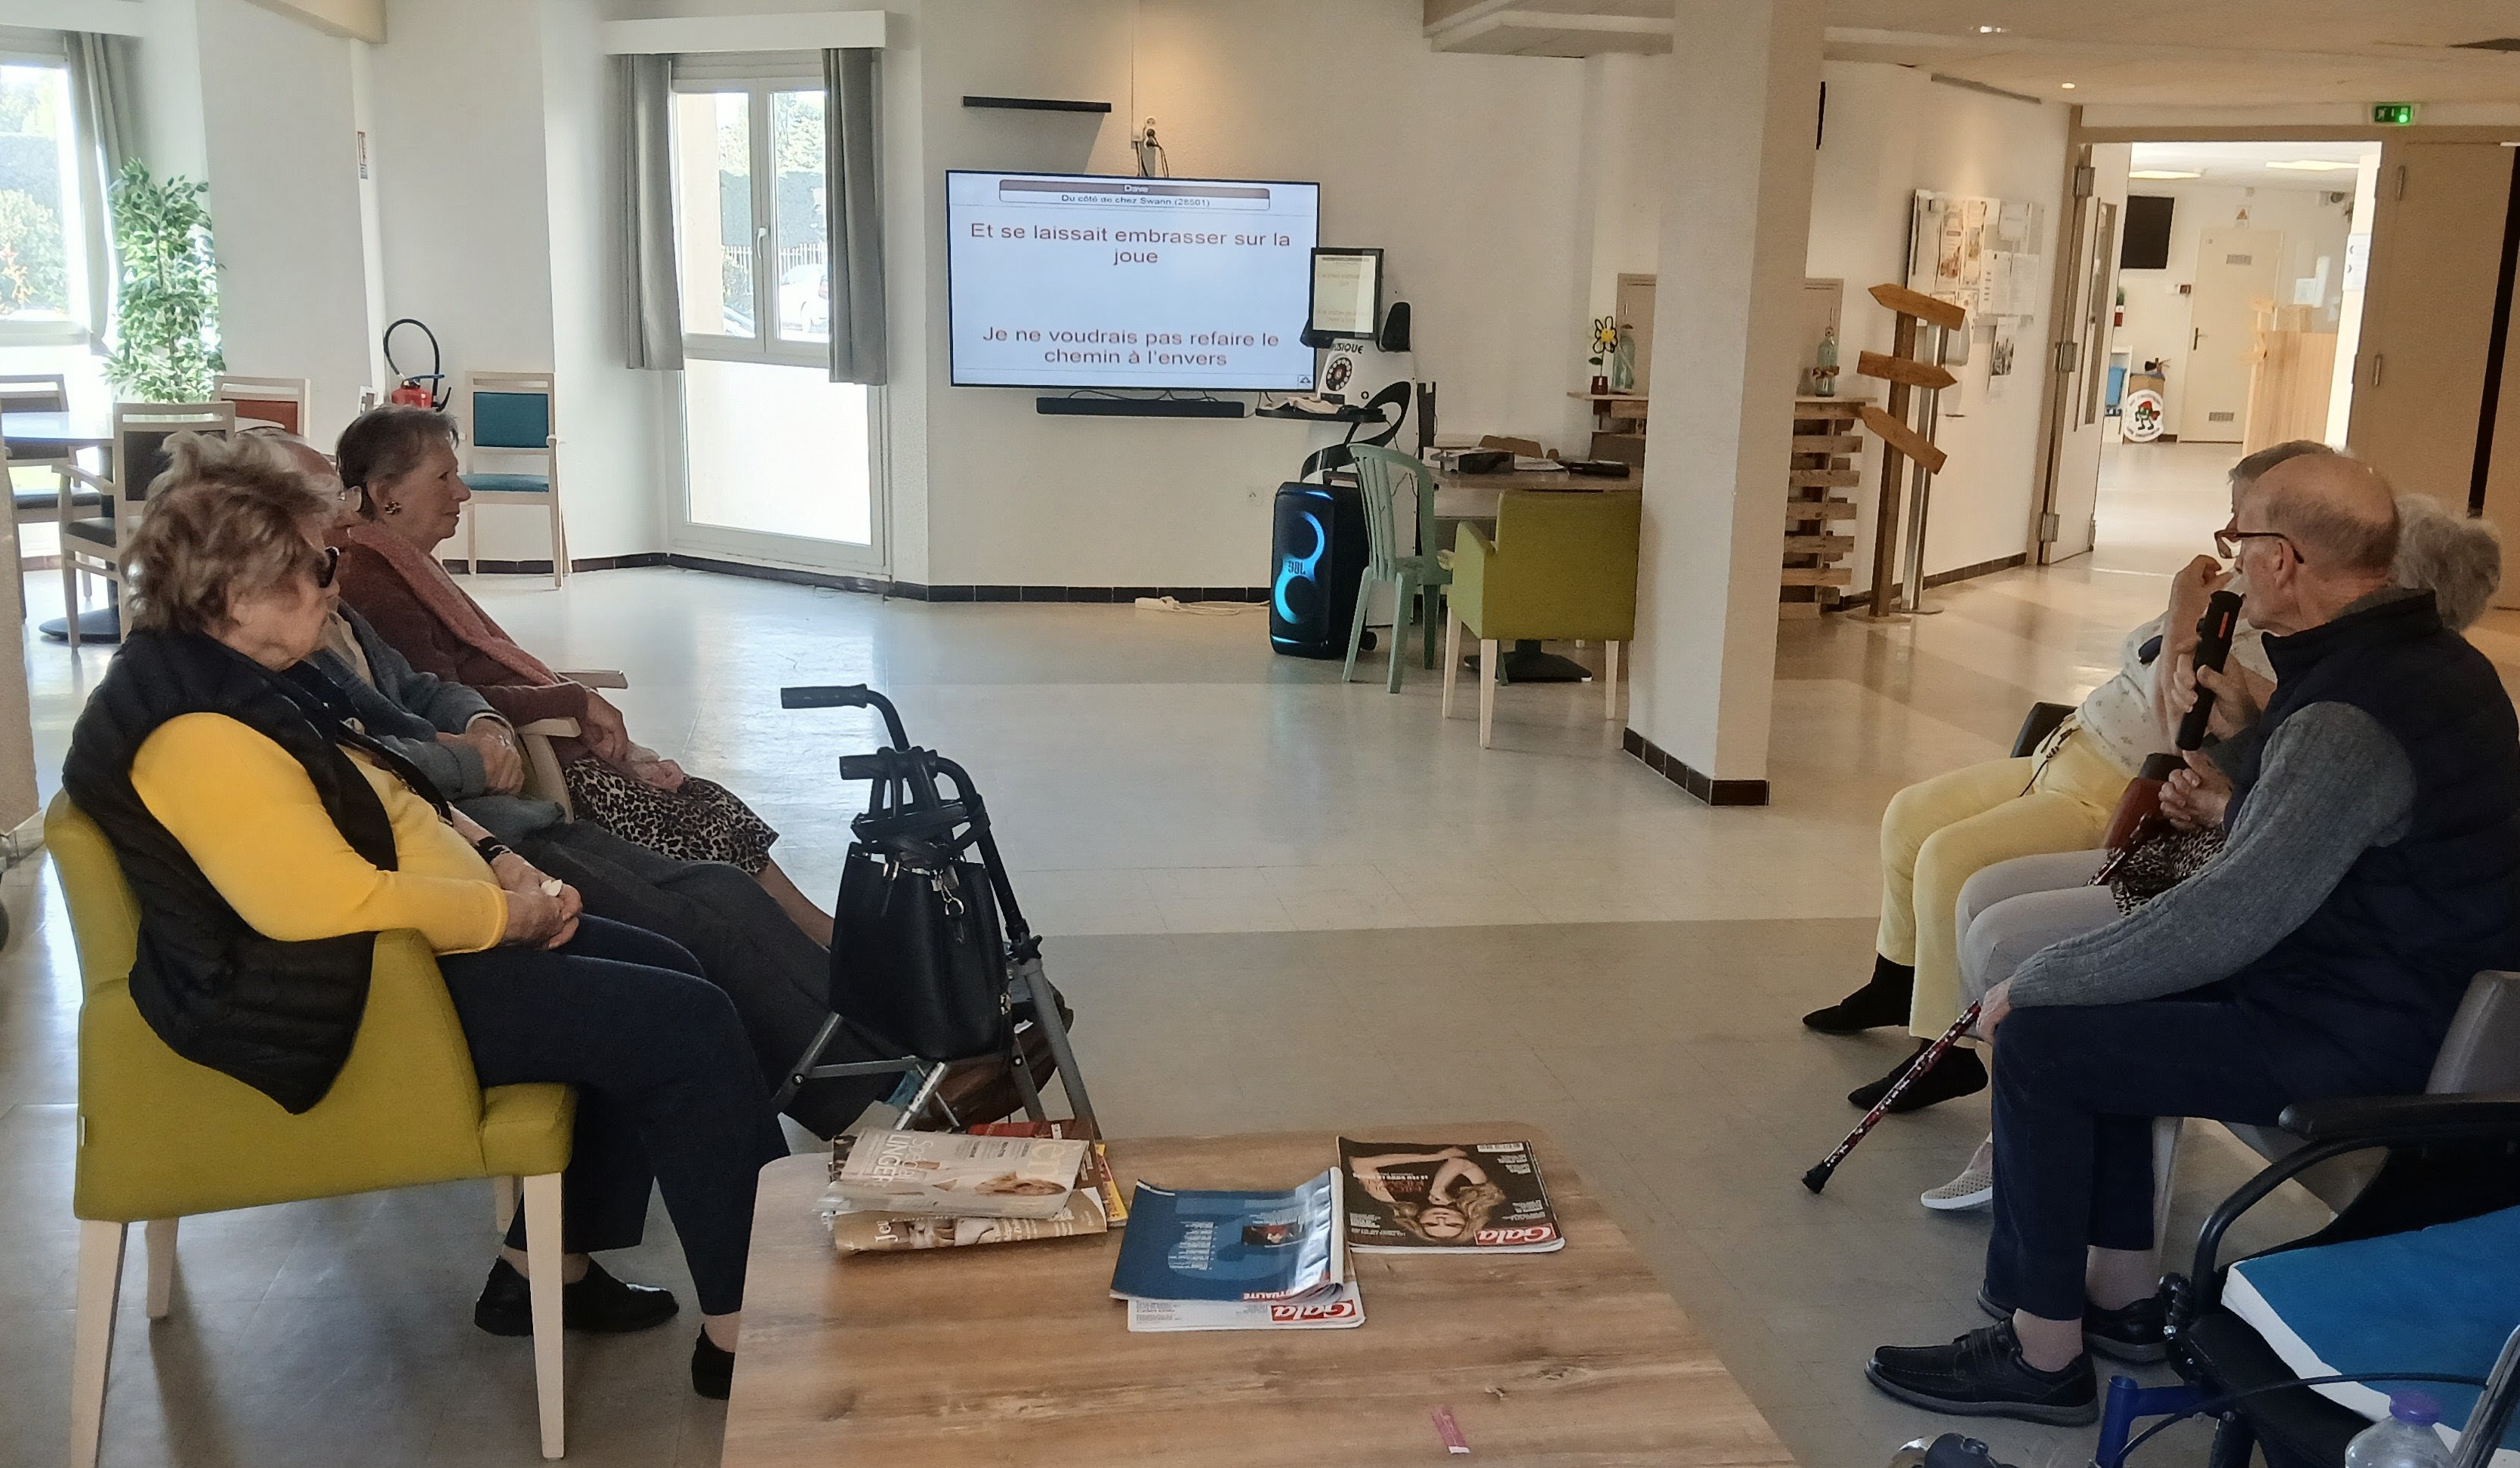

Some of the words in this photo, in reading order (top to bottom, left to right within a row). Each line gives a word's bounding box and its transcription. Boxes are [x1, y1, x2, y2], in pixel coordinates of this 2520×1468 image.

[1078, 196, 1098, 204] côté
[1100, 196, 1112, 204] de
[1115, 196, 1137, 205] chez
[1140, 197, 1171, 205] Swann
[971, 223, 994, 239] Et
[1001, 227, 1026, 240] se
[1034, 226, 1107, 242] laissait
[1115, 229, 1226, 245] embrasser
[1235, 233, 1266, 246] sur
[1274, 233, 1291, 247] la
[1113, 249, 1158, 266] joue
[983, 326, 1007, 342] Je
[1016, 330, 1041, 343] ne
[1049, 328, 1137, 344] voudrais
[1146, 333, 1182, 347] pas
[1190, 332, 1254, 347] refaire
[1263, 334, 1279, 347] le
[1044, 350, 1121, 364] chemin
[1128, 349, 1140, 364] à
[1149, 350, 1226, 366] l'envers
[1479, 1226, 1550, 1244] Gala
